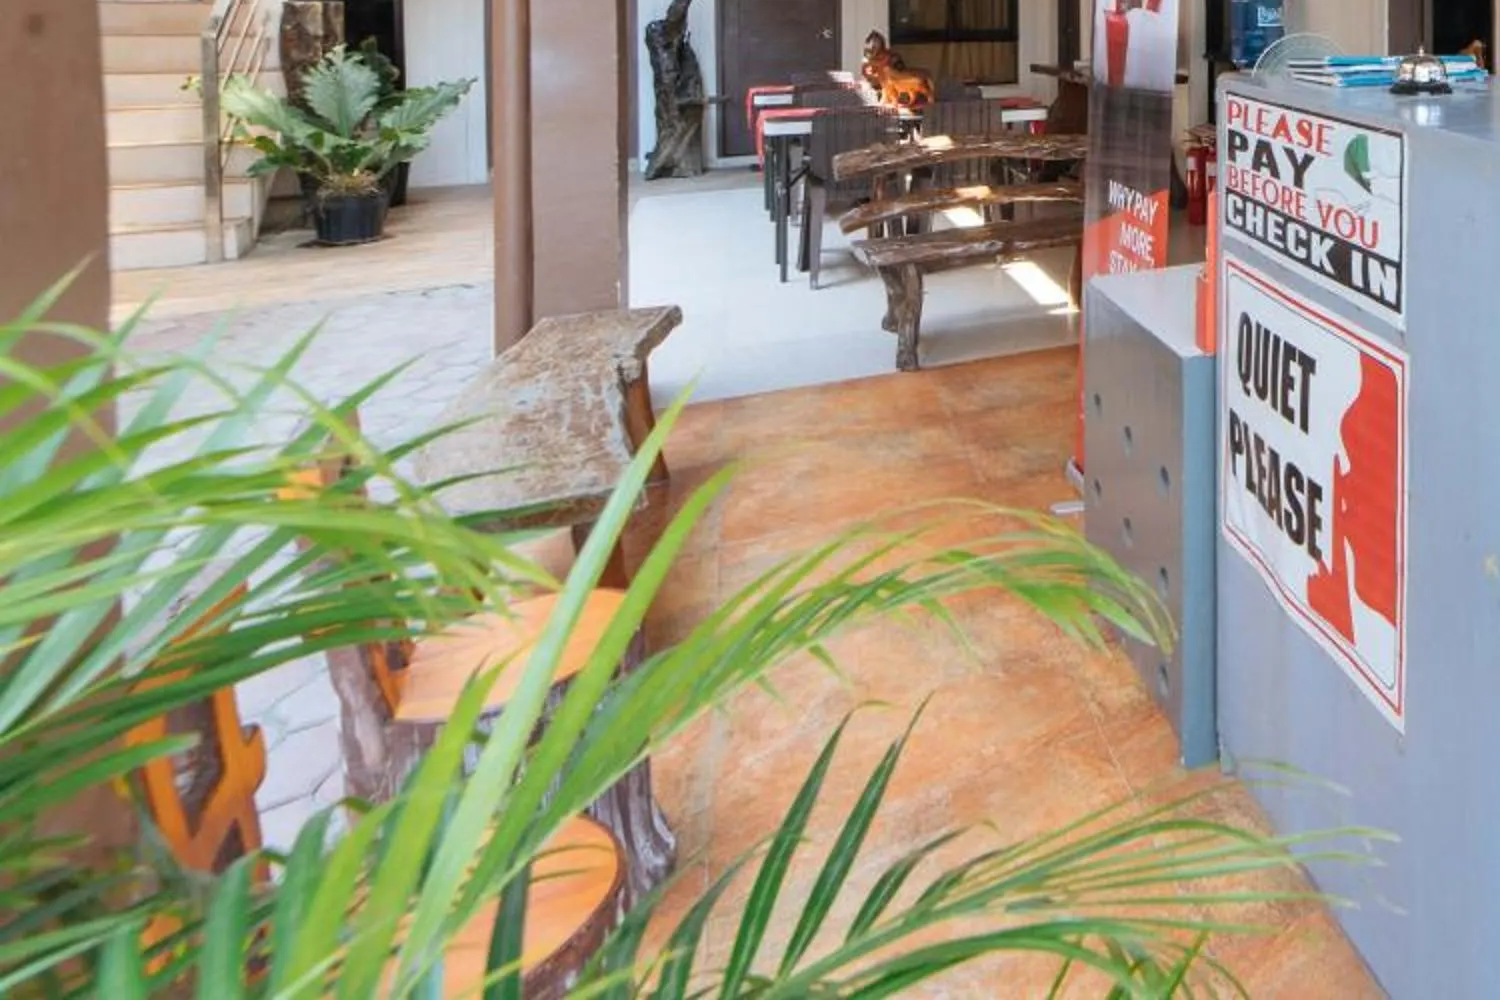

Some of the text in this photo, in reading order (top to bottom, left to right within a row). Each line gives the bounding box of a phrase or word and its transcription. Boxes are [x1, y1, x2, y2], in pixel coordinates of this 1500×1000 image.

[1227, 99, 1335, 157] PLEASE
[1227, 128, 1315, 189] PAY
[1109, 179, 1160, 227] WHY PAY
[1227, 166, 1380, 249] BEFORE YOU
[1227, 193, 1398, 306] CHECK IN
[1237, 311, 1316, 436] QUIET
[1229, 407, 1323, 562] PLEASE
